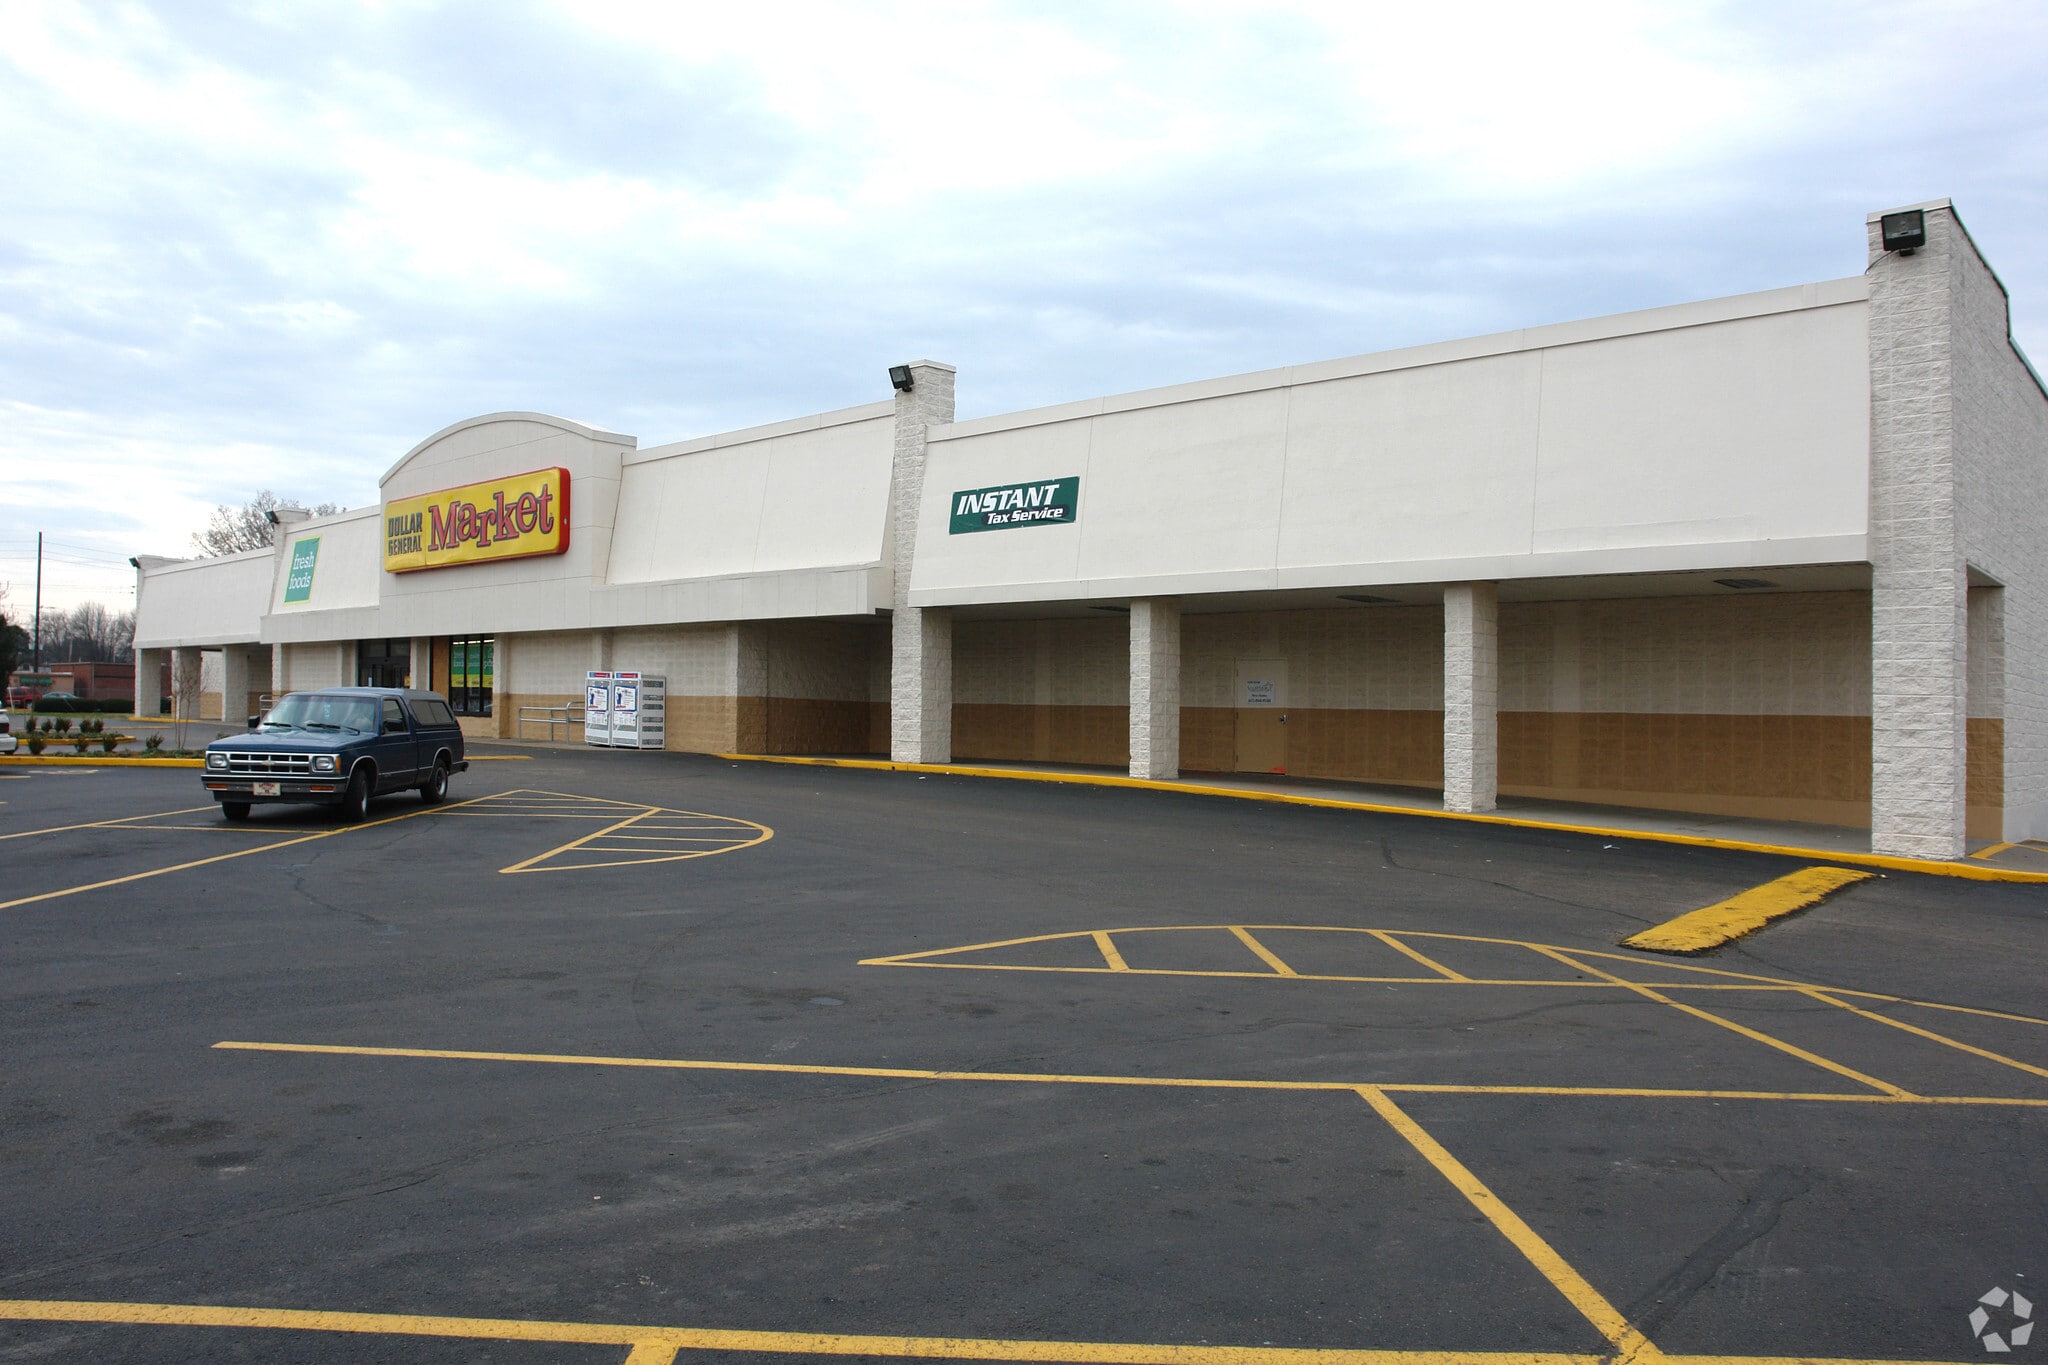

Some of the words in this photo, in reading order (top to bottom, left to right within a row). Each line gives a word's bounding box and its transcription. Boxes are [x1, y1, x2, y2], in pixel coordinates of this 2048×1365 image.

[956, 484, 1060, 515] INSTANT
[387, 511, 423, 538] DOLLAR
[427, 484, 554, 551] Market
[986, 512, 1011, 525] Tax
[1010, 507, 1064, 523] Service
[387, 534, 423, 557] GENERAL
[292, 551, 315, 570] fresh
[288, 572, 312, 590] foods
